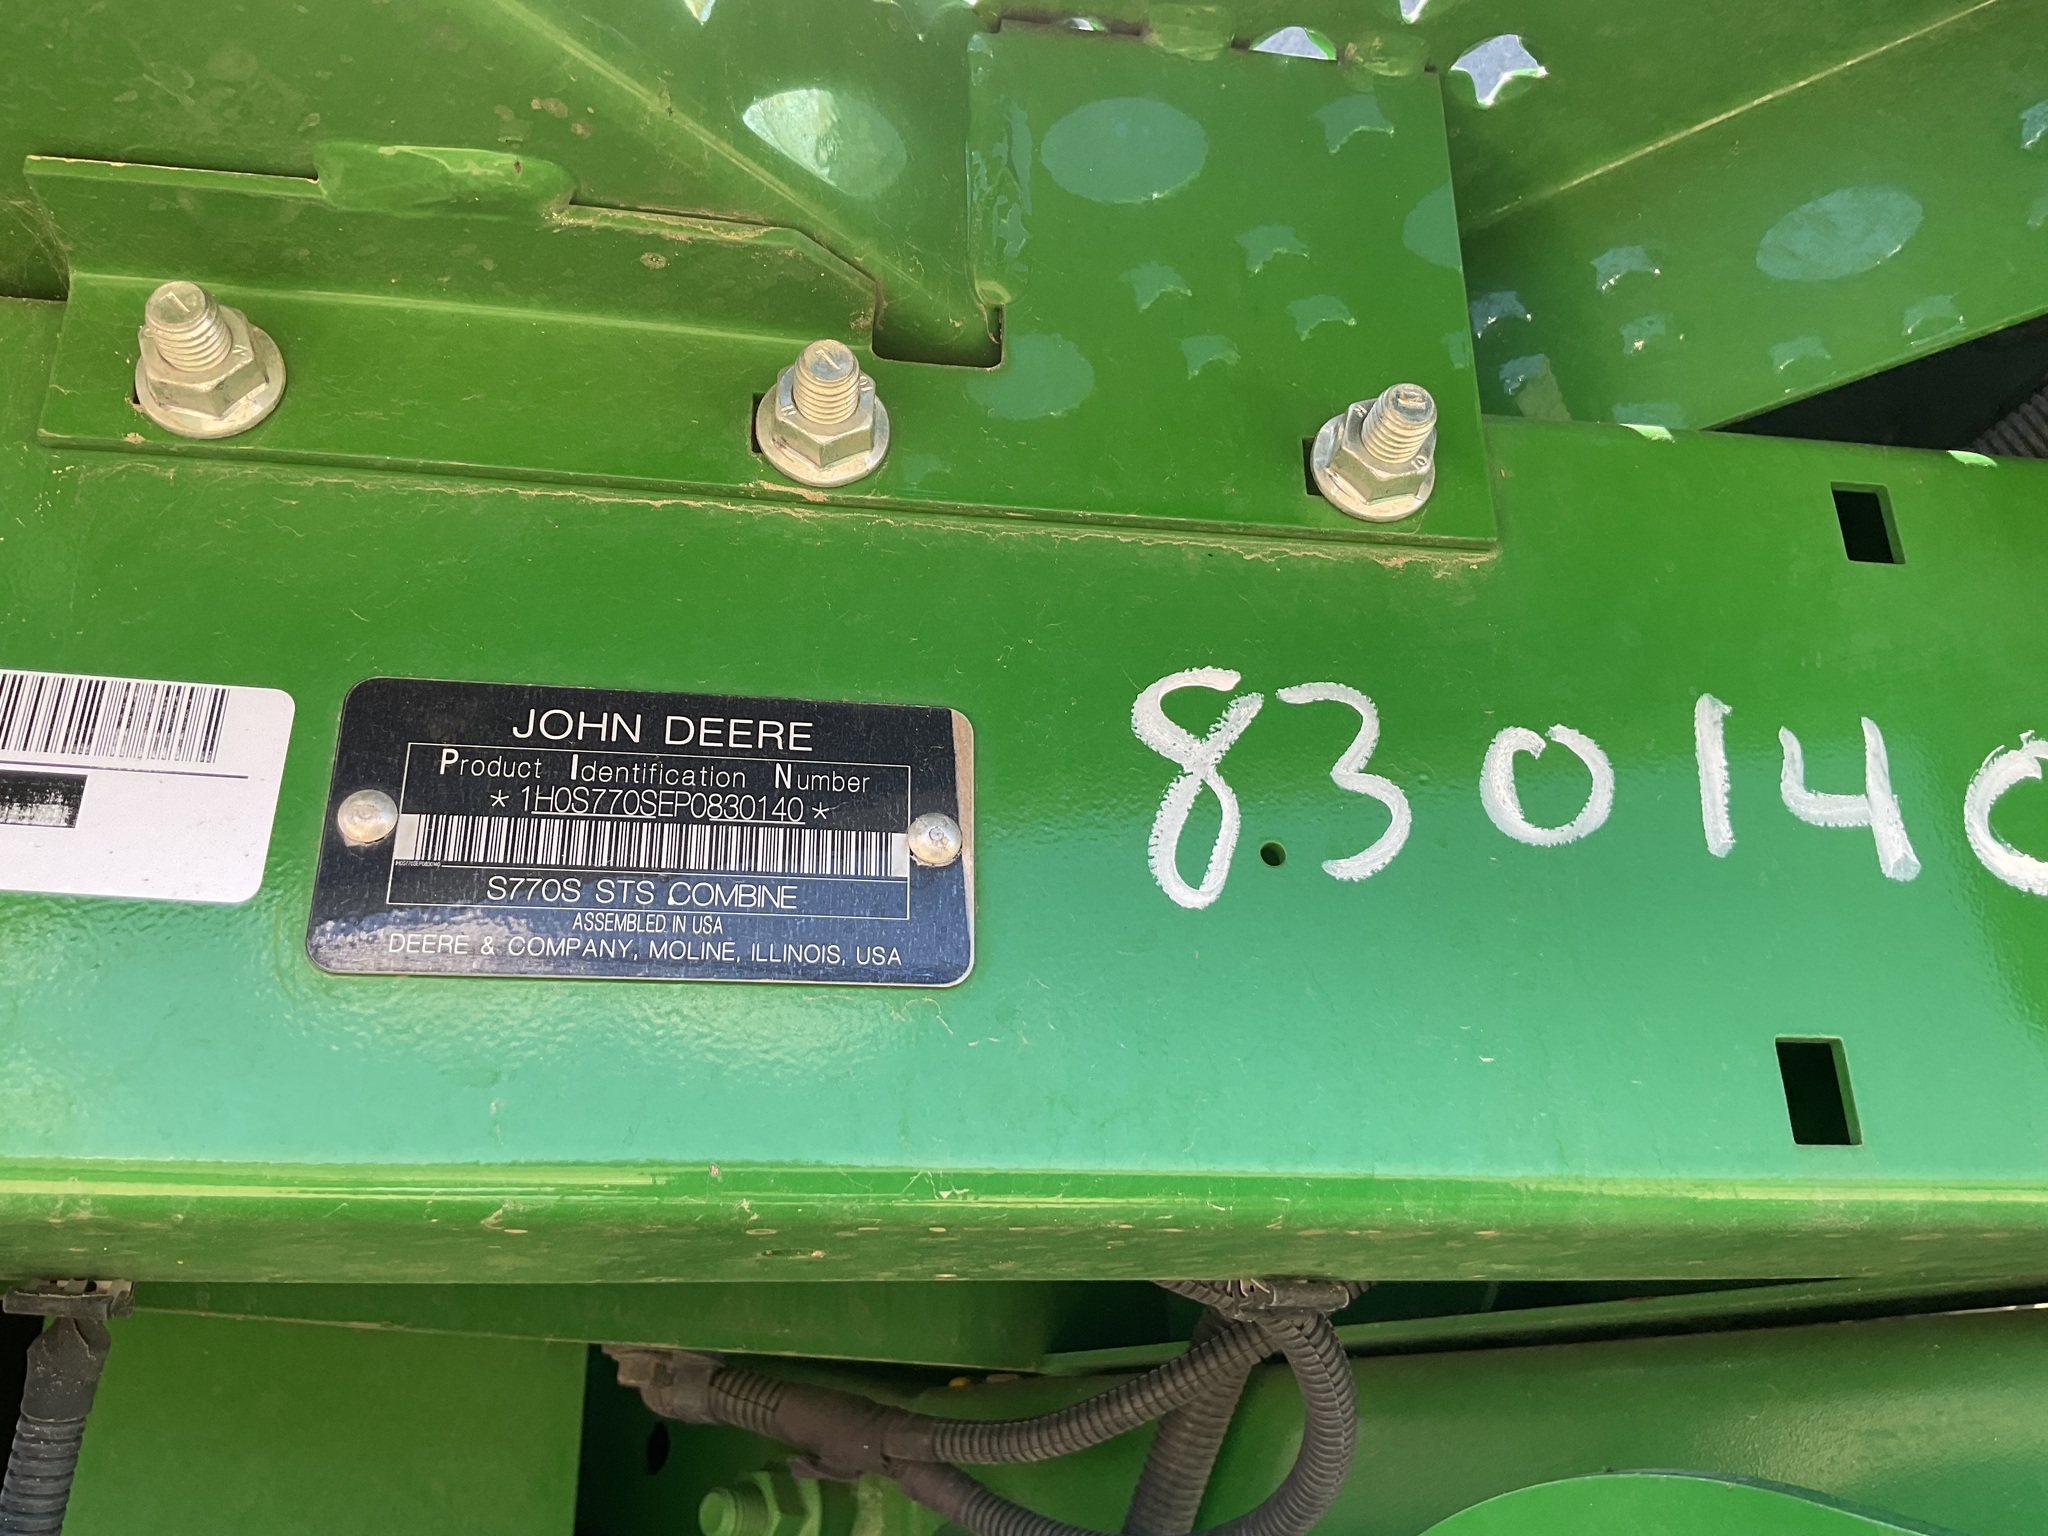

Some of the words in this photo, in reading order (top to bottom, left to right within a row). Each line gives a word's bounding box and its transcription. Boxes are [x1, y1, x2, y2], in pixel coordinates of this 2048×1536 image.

[512, 708, 642, 743] JOHN
[664, 715, 813, 751] DEERE
[440, 748, 542, 779] Product
[570, 754, 746, 788] Identification
[774, 762, 870, 793] Number
[487, 875, 581, 902] S770S
[595, 879, 655, 905] STS
[667, 881, 798, 909] COMBINE
[572, 912, 666, 933] ASSEMBLED
[672, 914, 686, 933] IN
[692, 915, 723, 934] USA
[389, 933, 470, 955] DEERE
[481, 935, 495, 955] &
[508, 936, 638, 961] COMPANY,
[649, 940, 740, 963] MOLINE,
[751, 944, 845, 966] ILLINOIS,
[856, 946, 902, 966] USA
